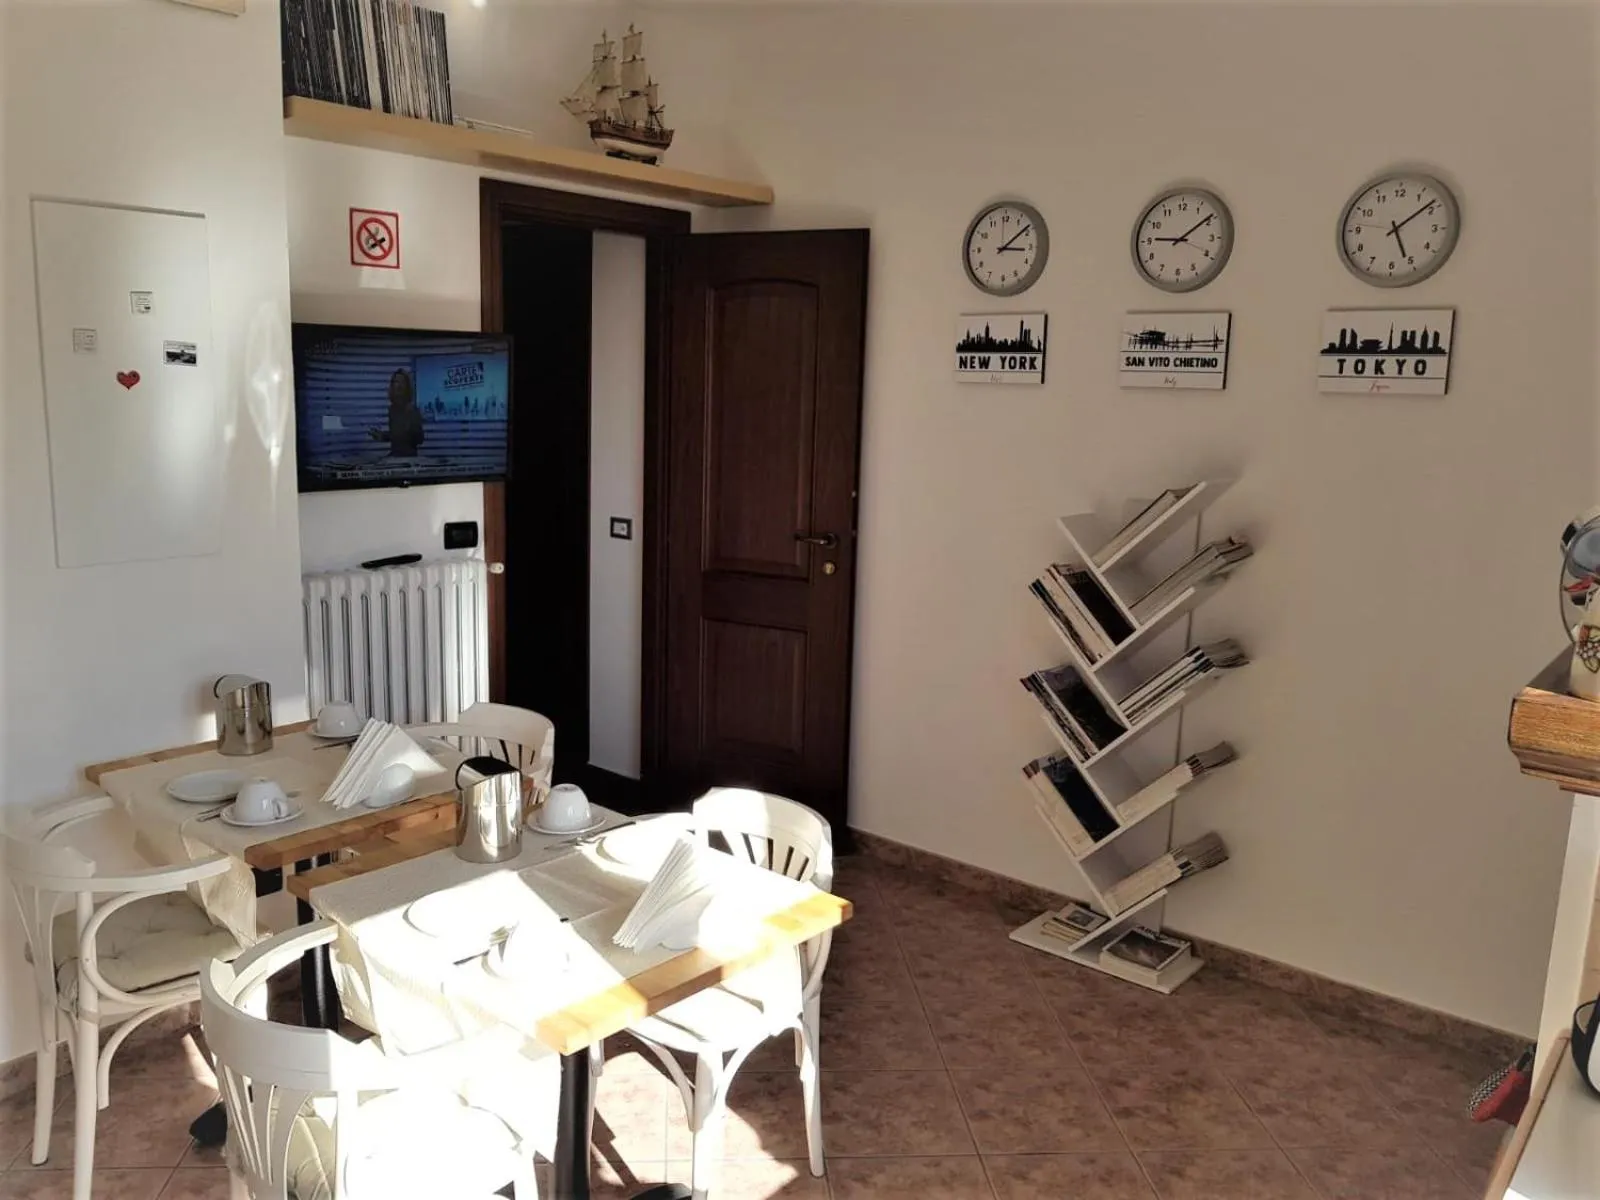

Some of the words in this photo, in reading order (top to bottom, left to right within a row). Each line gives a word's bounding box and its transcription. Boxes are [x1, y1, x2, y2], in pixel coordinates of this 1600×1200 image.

[1394, 189, 1406, 198] 12
[1377, 195, 1386, 204] 11
[1178, 203, 1188, 211] 12
[1428, 206, 1434, 215] 2
[1362, 209, 1373, 217] 10
[1152, 222, 1162, 230] 10
[1356, 226, 1361, 234] 9
[1432, 224, 1438, 232] 3
[1147, 237, 1152, 245] 9
[1210, 234, 1214, 242] 3
[1358, 244, 1363, 252] 8
[1424, 242, 1430, 250] 4
[1370, 256, 1376, 264] 7
[1408, 256, 1414, 264] 5
[1389, 261, 1395, 270] 6
[1175, 268, 1180, 276] 6
[958, 356, 990, 370] NEW
[1000, 356, 1037, 370] YORK
[1125, 356, 1145, 367] SAN
[1149, 357, 1170, 368] VITO
[1174, 357, 1218, 368] CHIETINO
[1337, 358, 1427, 376] TOKYO
